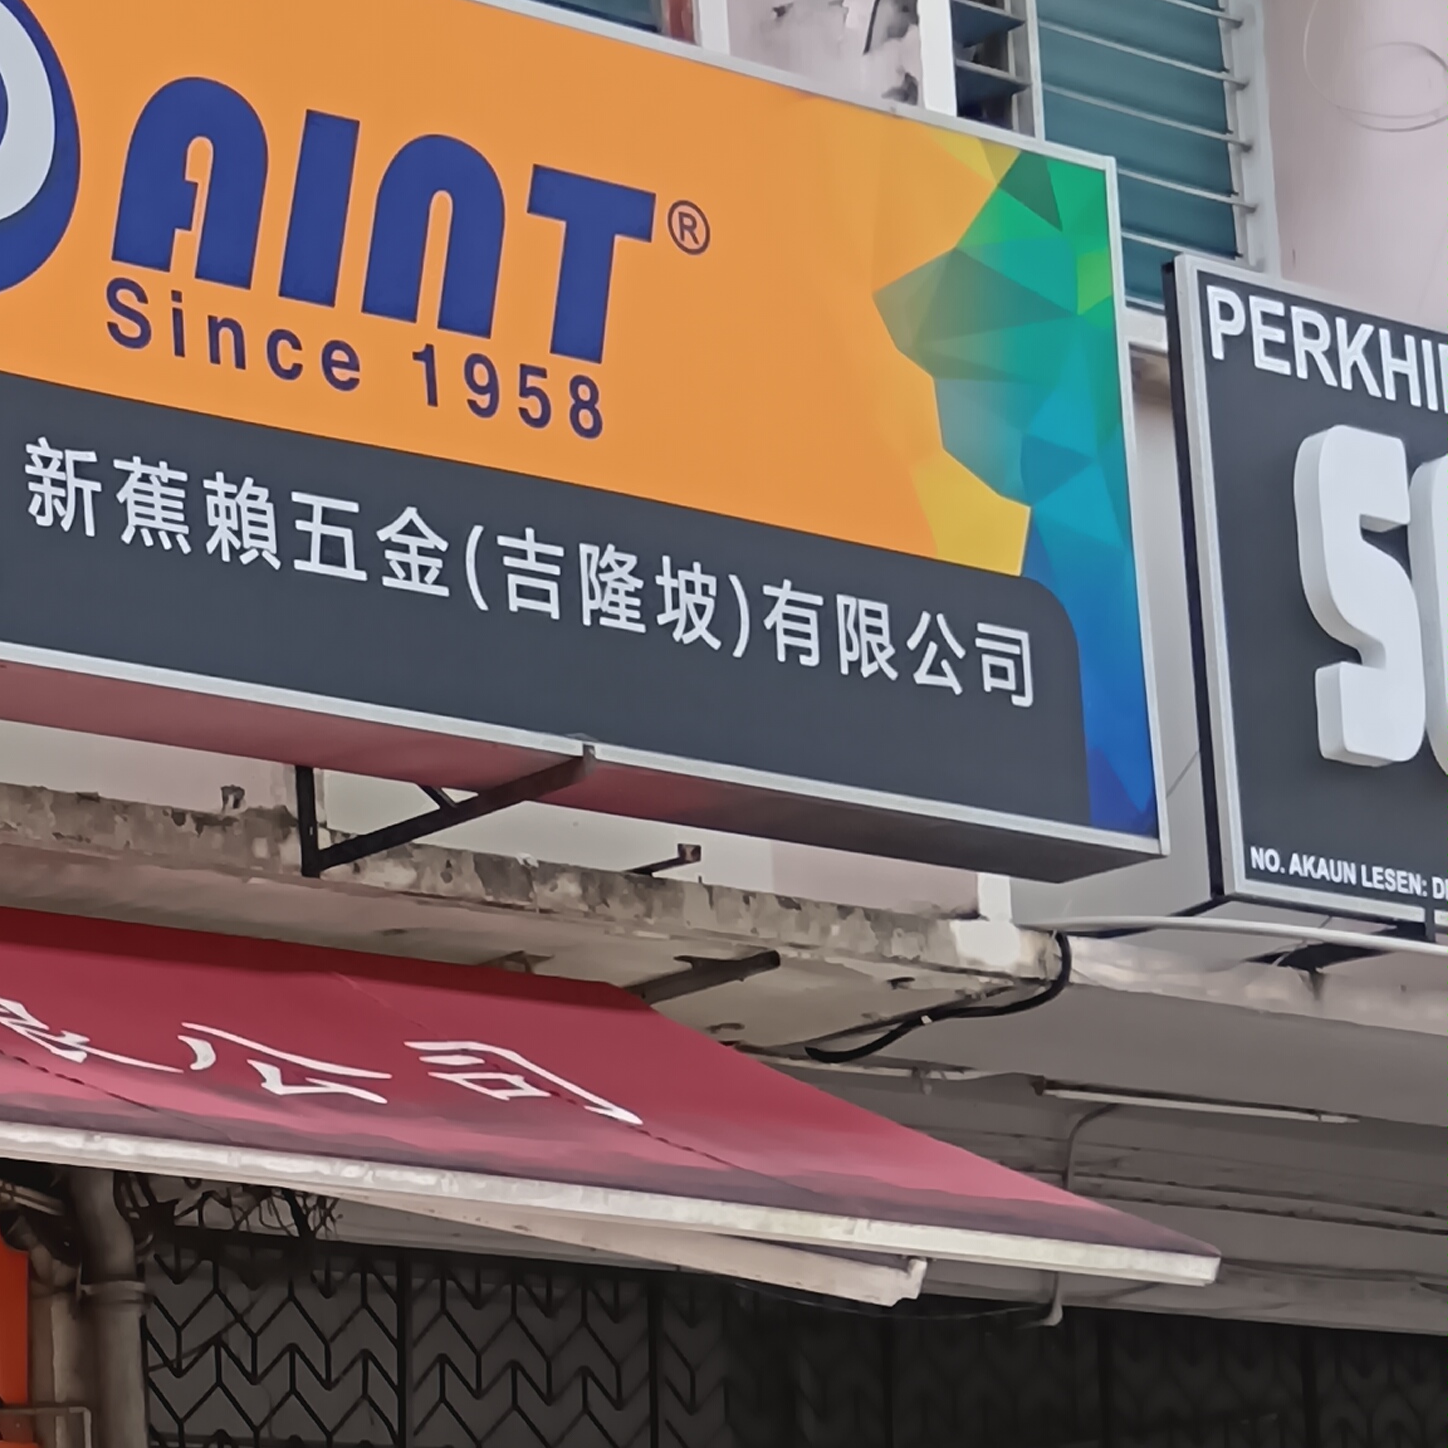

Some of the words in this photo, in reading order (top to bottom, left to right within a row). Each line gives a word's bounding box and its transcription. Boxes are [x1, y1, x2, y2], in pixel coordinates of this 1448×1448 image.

[104, 276, 362, 392] Since
[411, 342, 604, 440] 1958
[1206, 284, 1448, 415] PERKHI
[1250, 845, 1286, 874] NO.
[1288, 851, 1357, 885] AKAUN
[1360, 863, 1428, 897] LESEN:
